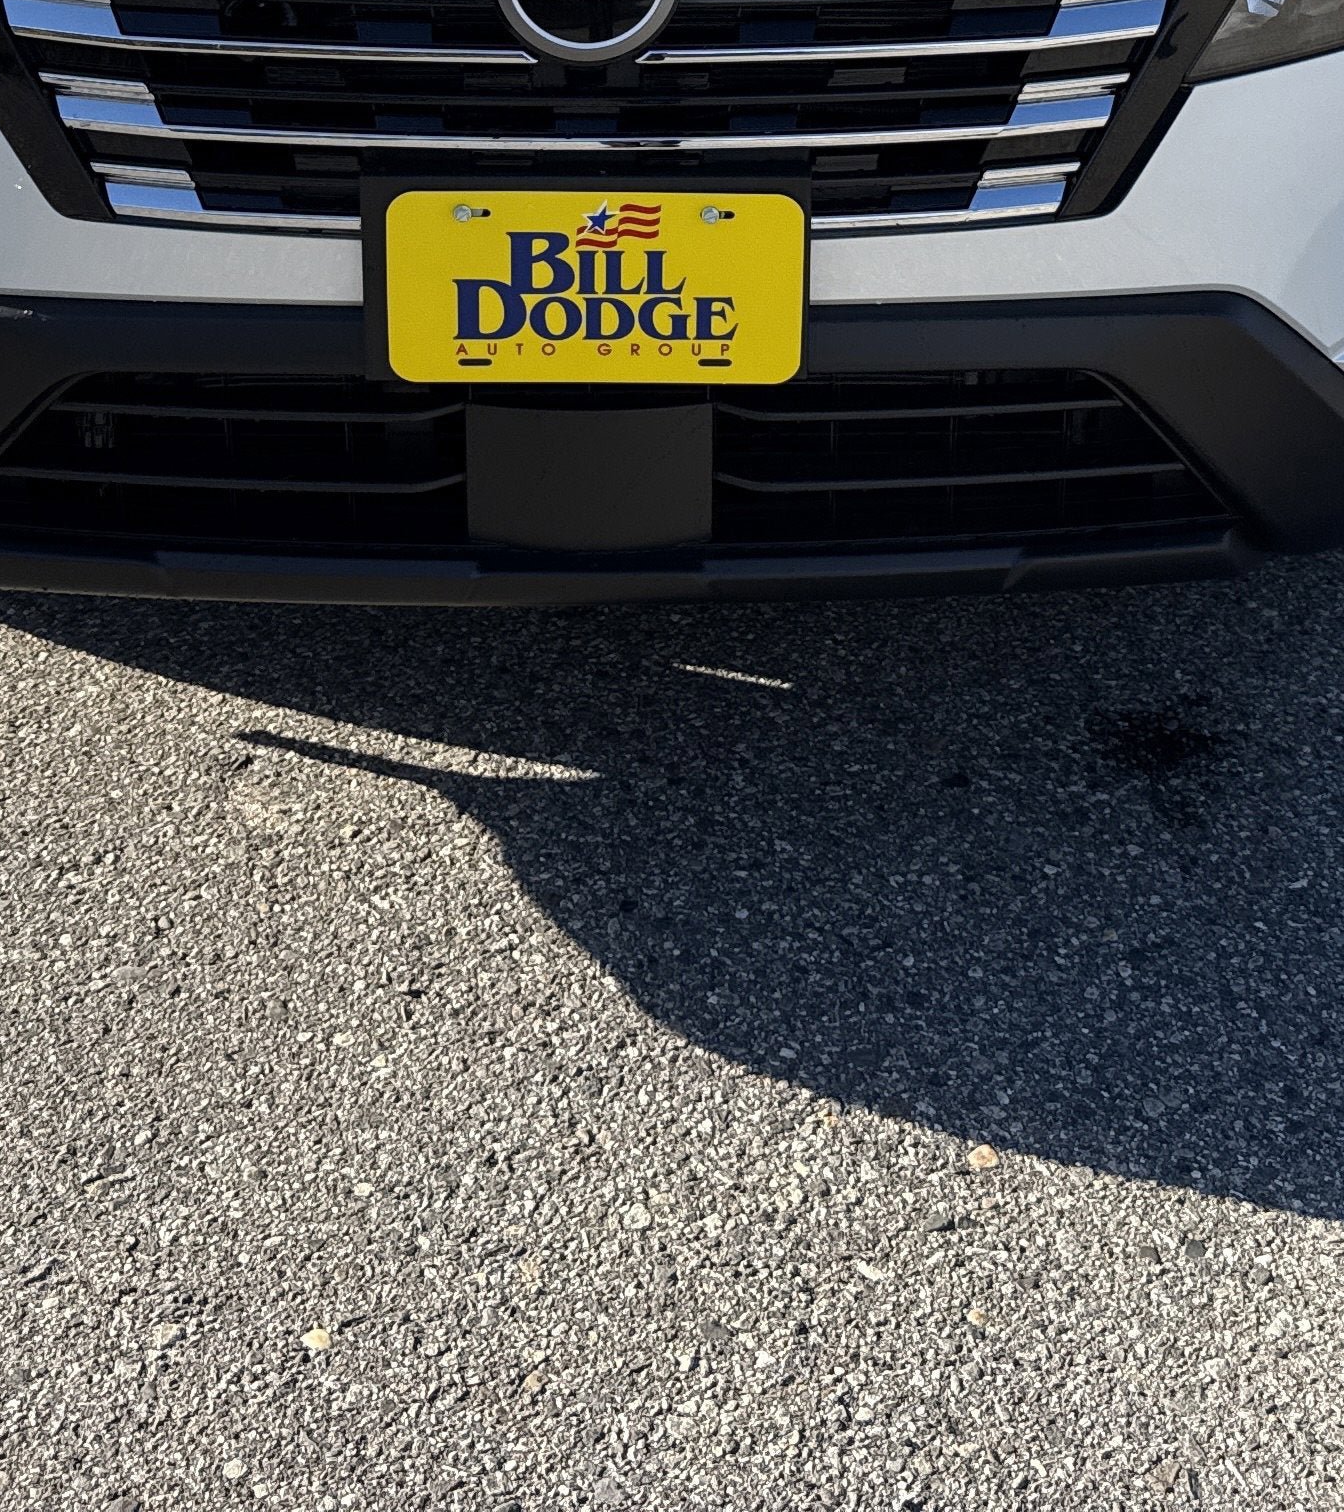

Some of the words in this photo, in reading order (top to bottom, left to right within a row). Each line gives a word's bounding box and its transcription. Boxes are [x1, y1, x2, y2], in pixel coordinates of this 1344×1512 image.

[506, 231, 687, 295] BILL
[452, 278, 739, 341] DODGE
[455, 342, 556, 356] AUTO
[597, 342, 731, 356] GROUP
